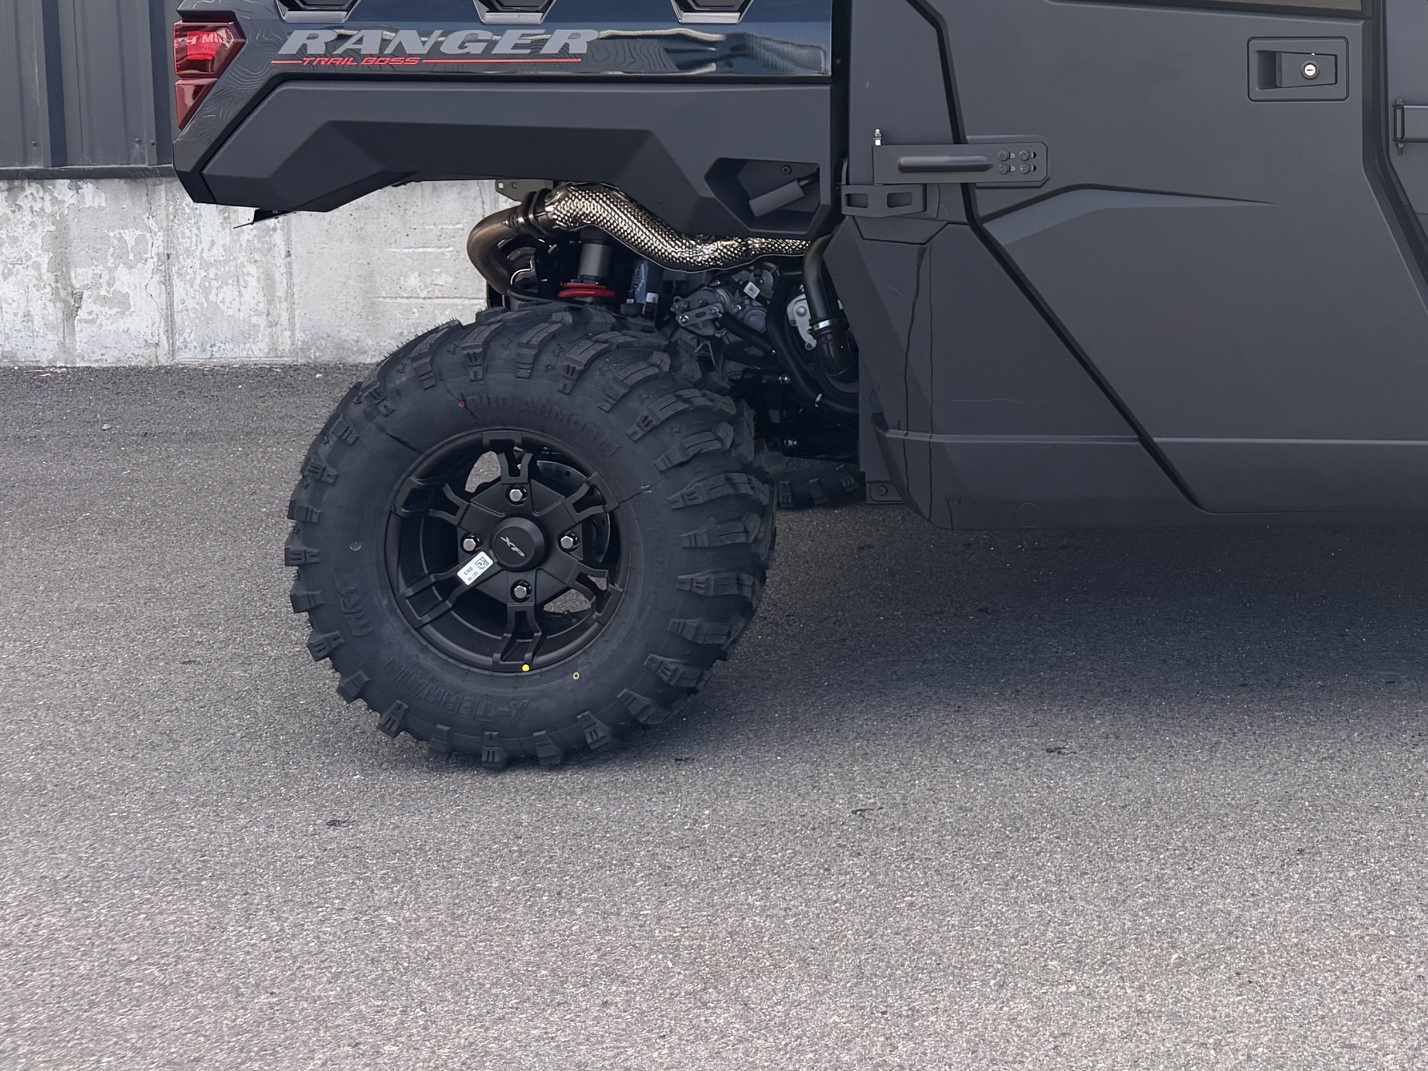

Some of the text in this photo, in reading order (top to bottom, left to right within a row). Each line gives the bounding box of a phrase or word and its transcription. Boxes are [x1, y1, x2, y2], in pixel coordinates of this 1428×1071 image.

[278, 29, 600, 55] RANGER
[302, 57, 421, 66] TRAIL BOSS
[500, 536, 525, 557] XP
[382, 657, 530, 722] X-TERRAIN
